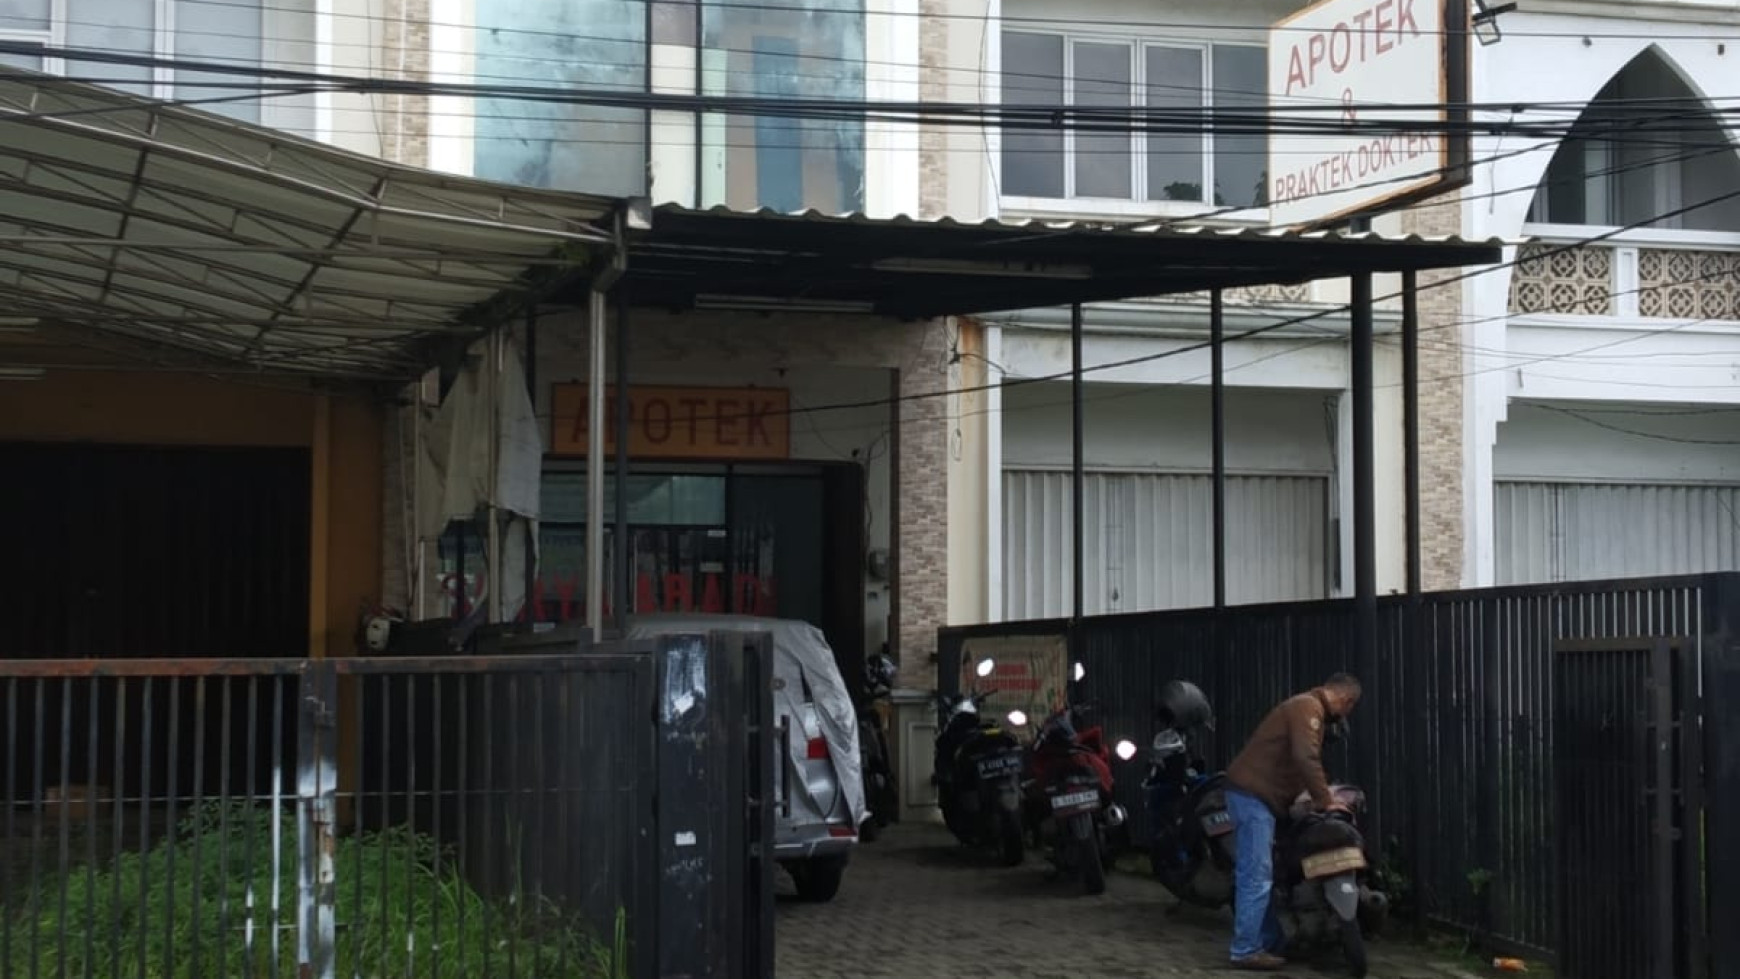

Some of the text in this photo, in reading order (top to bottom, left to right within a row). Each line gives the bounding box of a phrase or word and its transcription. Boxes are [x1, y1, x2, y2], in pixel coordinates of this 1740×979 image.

[1285, 0, 1420, 97] APOTEK
[1340, 87, 1359, 129] &
[1274, 130, 1434, 208] PRAKTEK DOKTER
[571, 396, 776, 447] APOTEK
